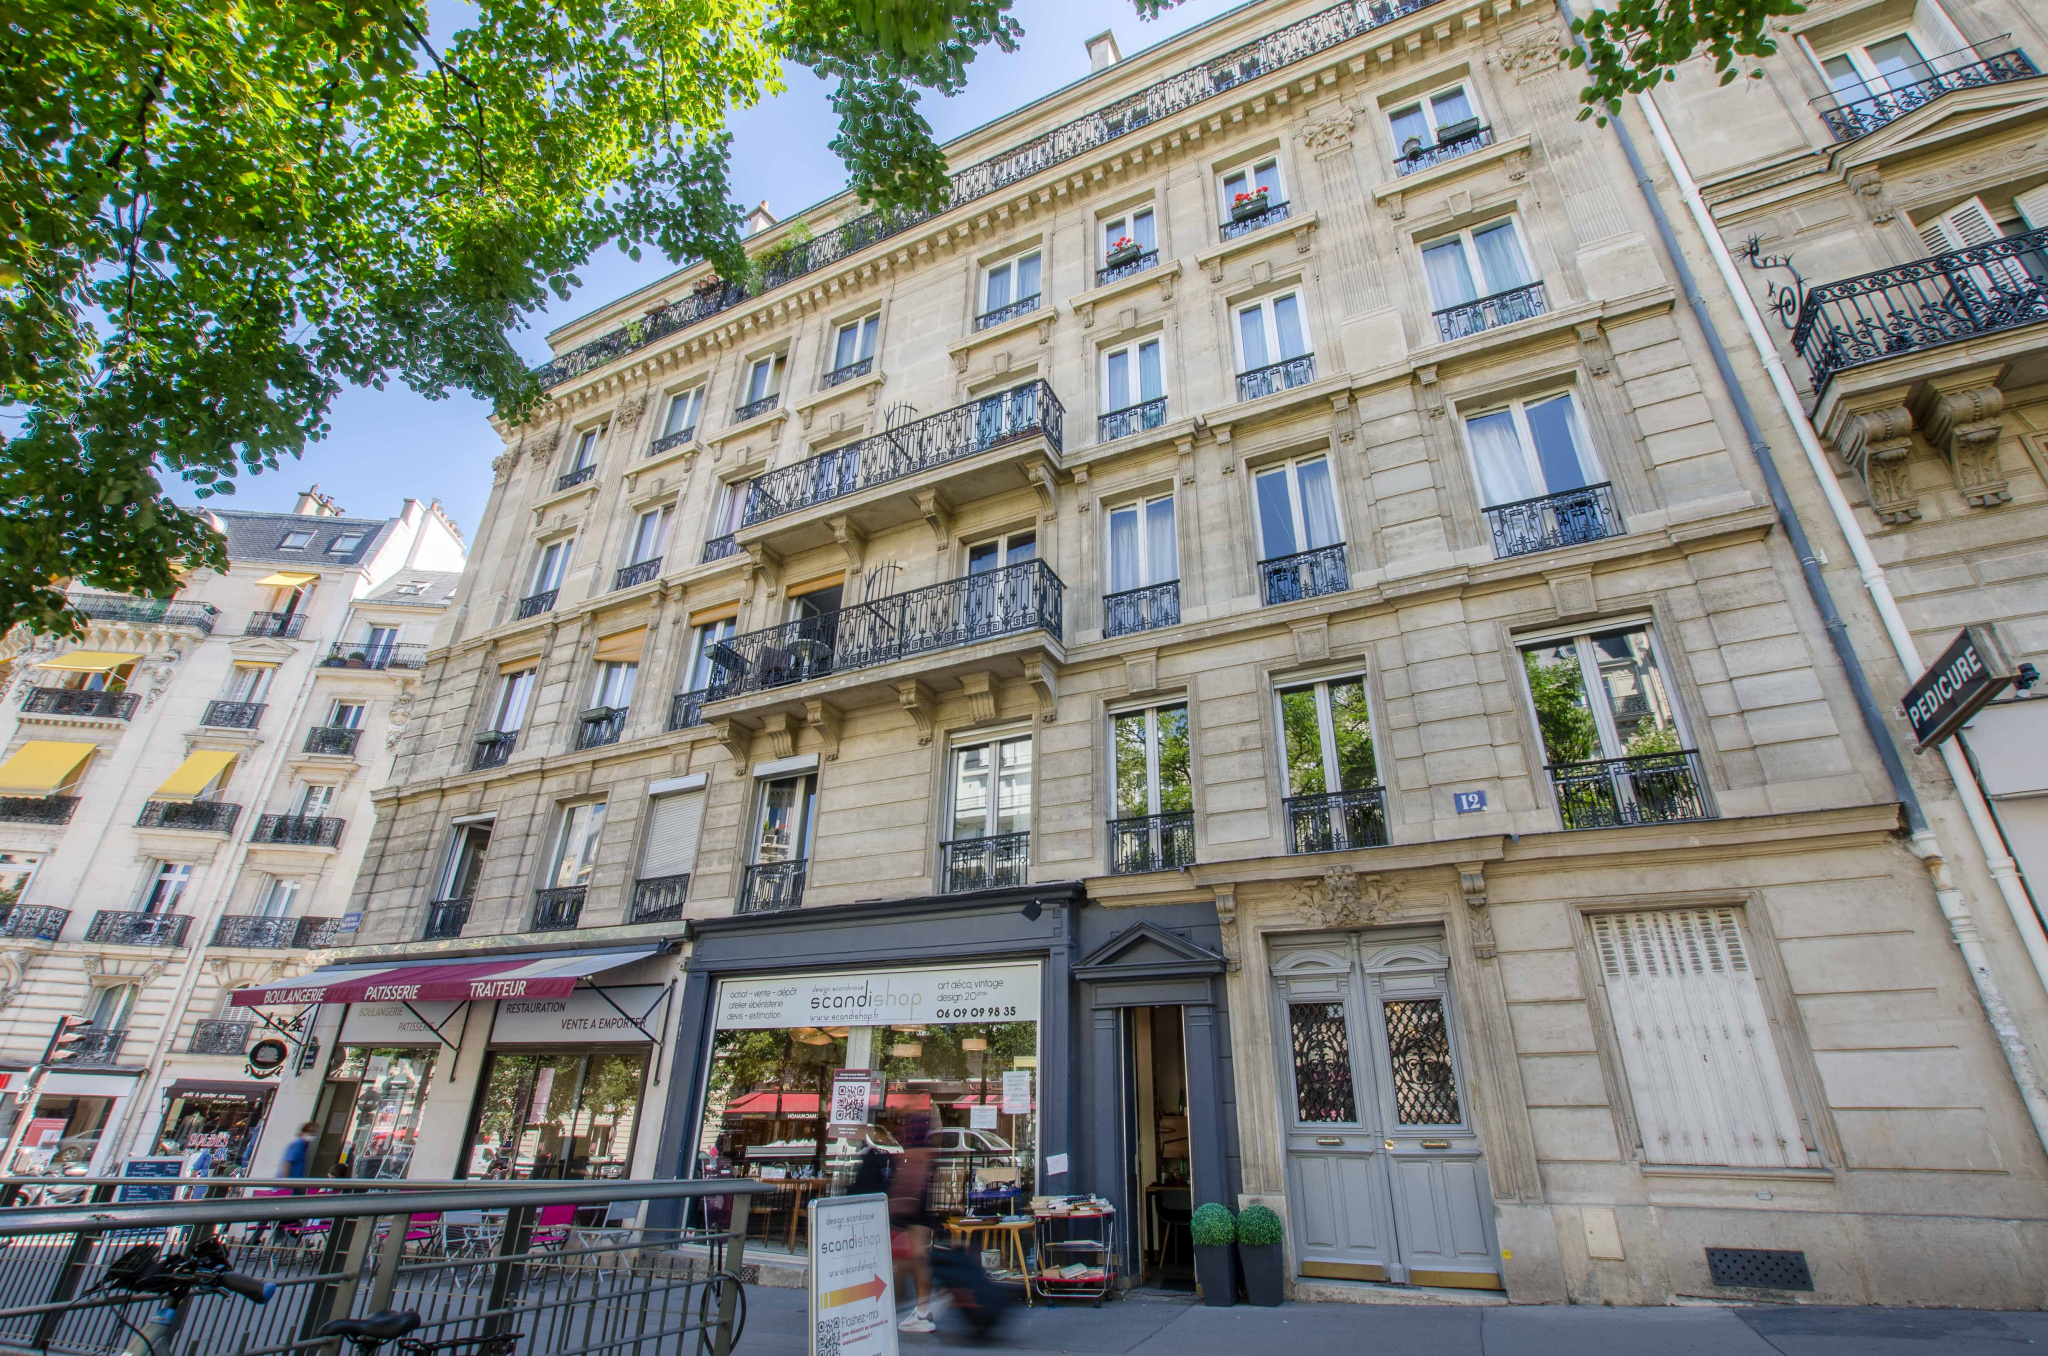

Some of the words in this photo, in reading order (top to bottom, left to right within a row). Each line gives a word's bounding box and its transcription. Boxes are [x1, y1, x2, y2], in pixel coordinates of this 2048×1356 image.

[1908, 645, 1982, 729] PEDICURE
[1460, 793, 1481, 810] 12
[364, 984, 421, 1000] PATISSERIE
[470, 980, 527, 998] TRAITEUR
[812, 984, 831, 997] design
[832, 982, 865, 992] scandinave
[937, 981, 949, 990] art
[951, 979, 973, 990] déco,
[974, 978, 1005, 991] vintage
[264, 988, 327, 1004] BOULANGERIE
[730, 989, 748, 999] achat
[754, 990, 771, 998] vente
[778, 987, 797, 998] dépôt
[810, 979, 922, 1020] scandishop
[936, 991, 963, 1003] design
[359, 1006, 404, 1017] BOULANGERIE
[506, 1001, 566, 1014] RESTAURATION
[728, 1000, 747, 1010] atelier
[748, 1000, 784, 1009] ébénisterie
[936, 1008, 950, 1019] 06
[953, 1008, 968, 1018] 09
[970, 1007, 985, 1018] 09
[987, 1007, 1001, 1017] 98
[1003, 1006, 1017, 1016] 35
[561, 1018, 587, 1030] VENTE
[590, 1018, 596, 1029] A
[598, 1017, 646, 1029] EMPORTER
[726, 1013, 743, 1021] devis
[749, 1012, 780, 1020] estimation
[398, 1021, 435, 1032] PATISSERIE
[187, 1132, 230, 1148] SOLDES
[826, 1212, 845, 1231] design
[846, 1209, 875, 1223] scandinave
[821, 1225, 881, 1256] scandishop
[828, 1257, 878, 1278] www.scandishop.fr
[841, 1307, 879, 1329] Flashez-moi
